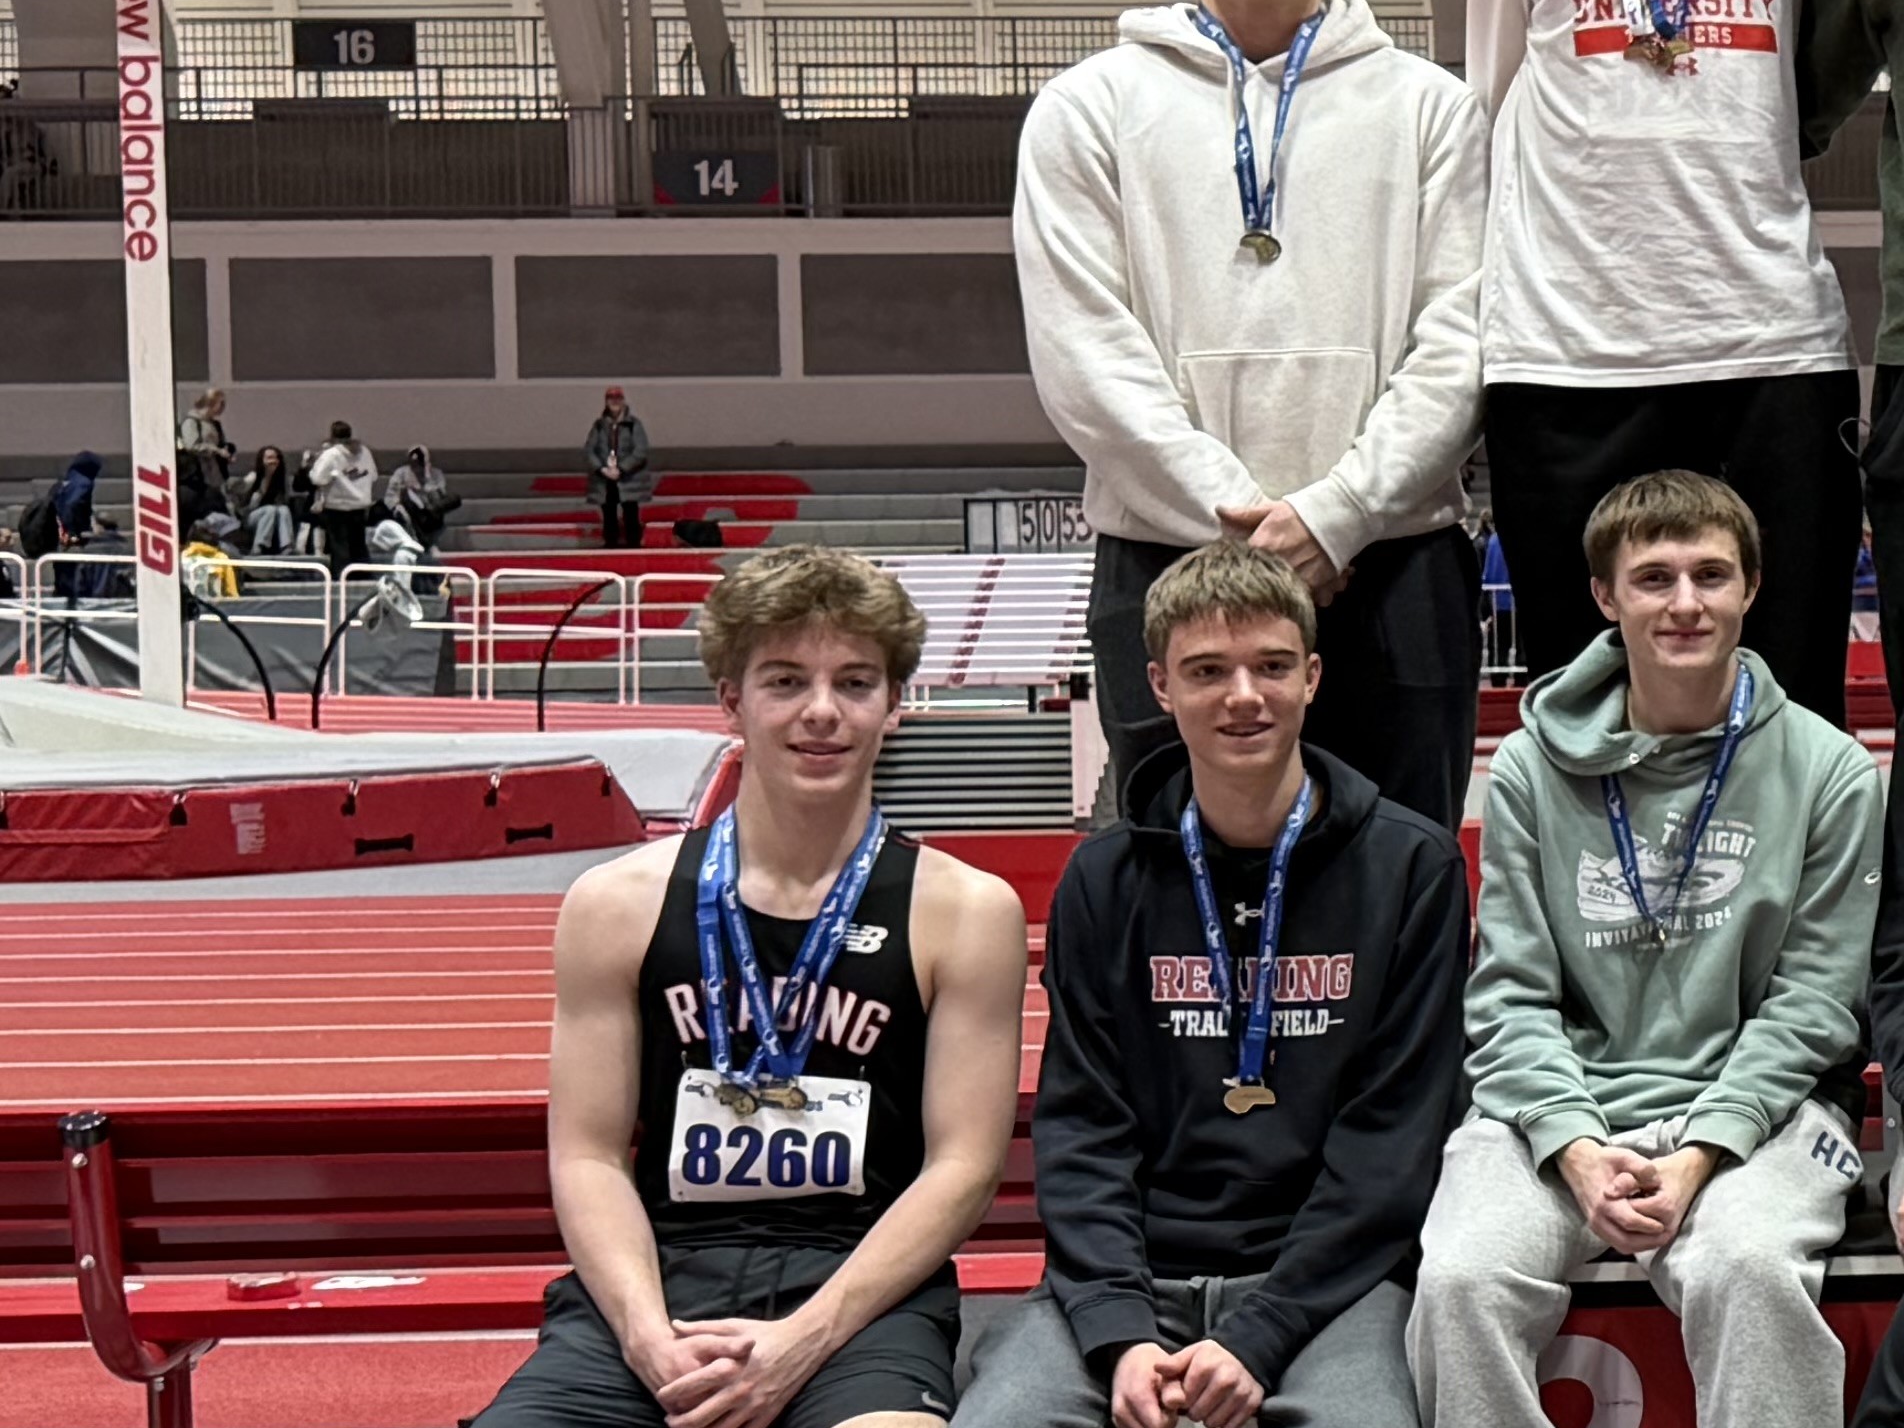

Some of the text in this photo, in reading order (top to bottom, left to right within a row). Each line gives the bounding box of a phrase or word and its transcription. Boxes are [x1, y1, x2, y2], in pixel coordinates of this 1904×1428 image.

[333, 29, 376, 65] 16
[119, 55, 163, 262] balance
[693, 159, 739, 197] 14
[137, 464, 174, 576] GILL
[681, 1123, 852, 1189] 8260
[1811, 1130, 1860, 1180] HC
